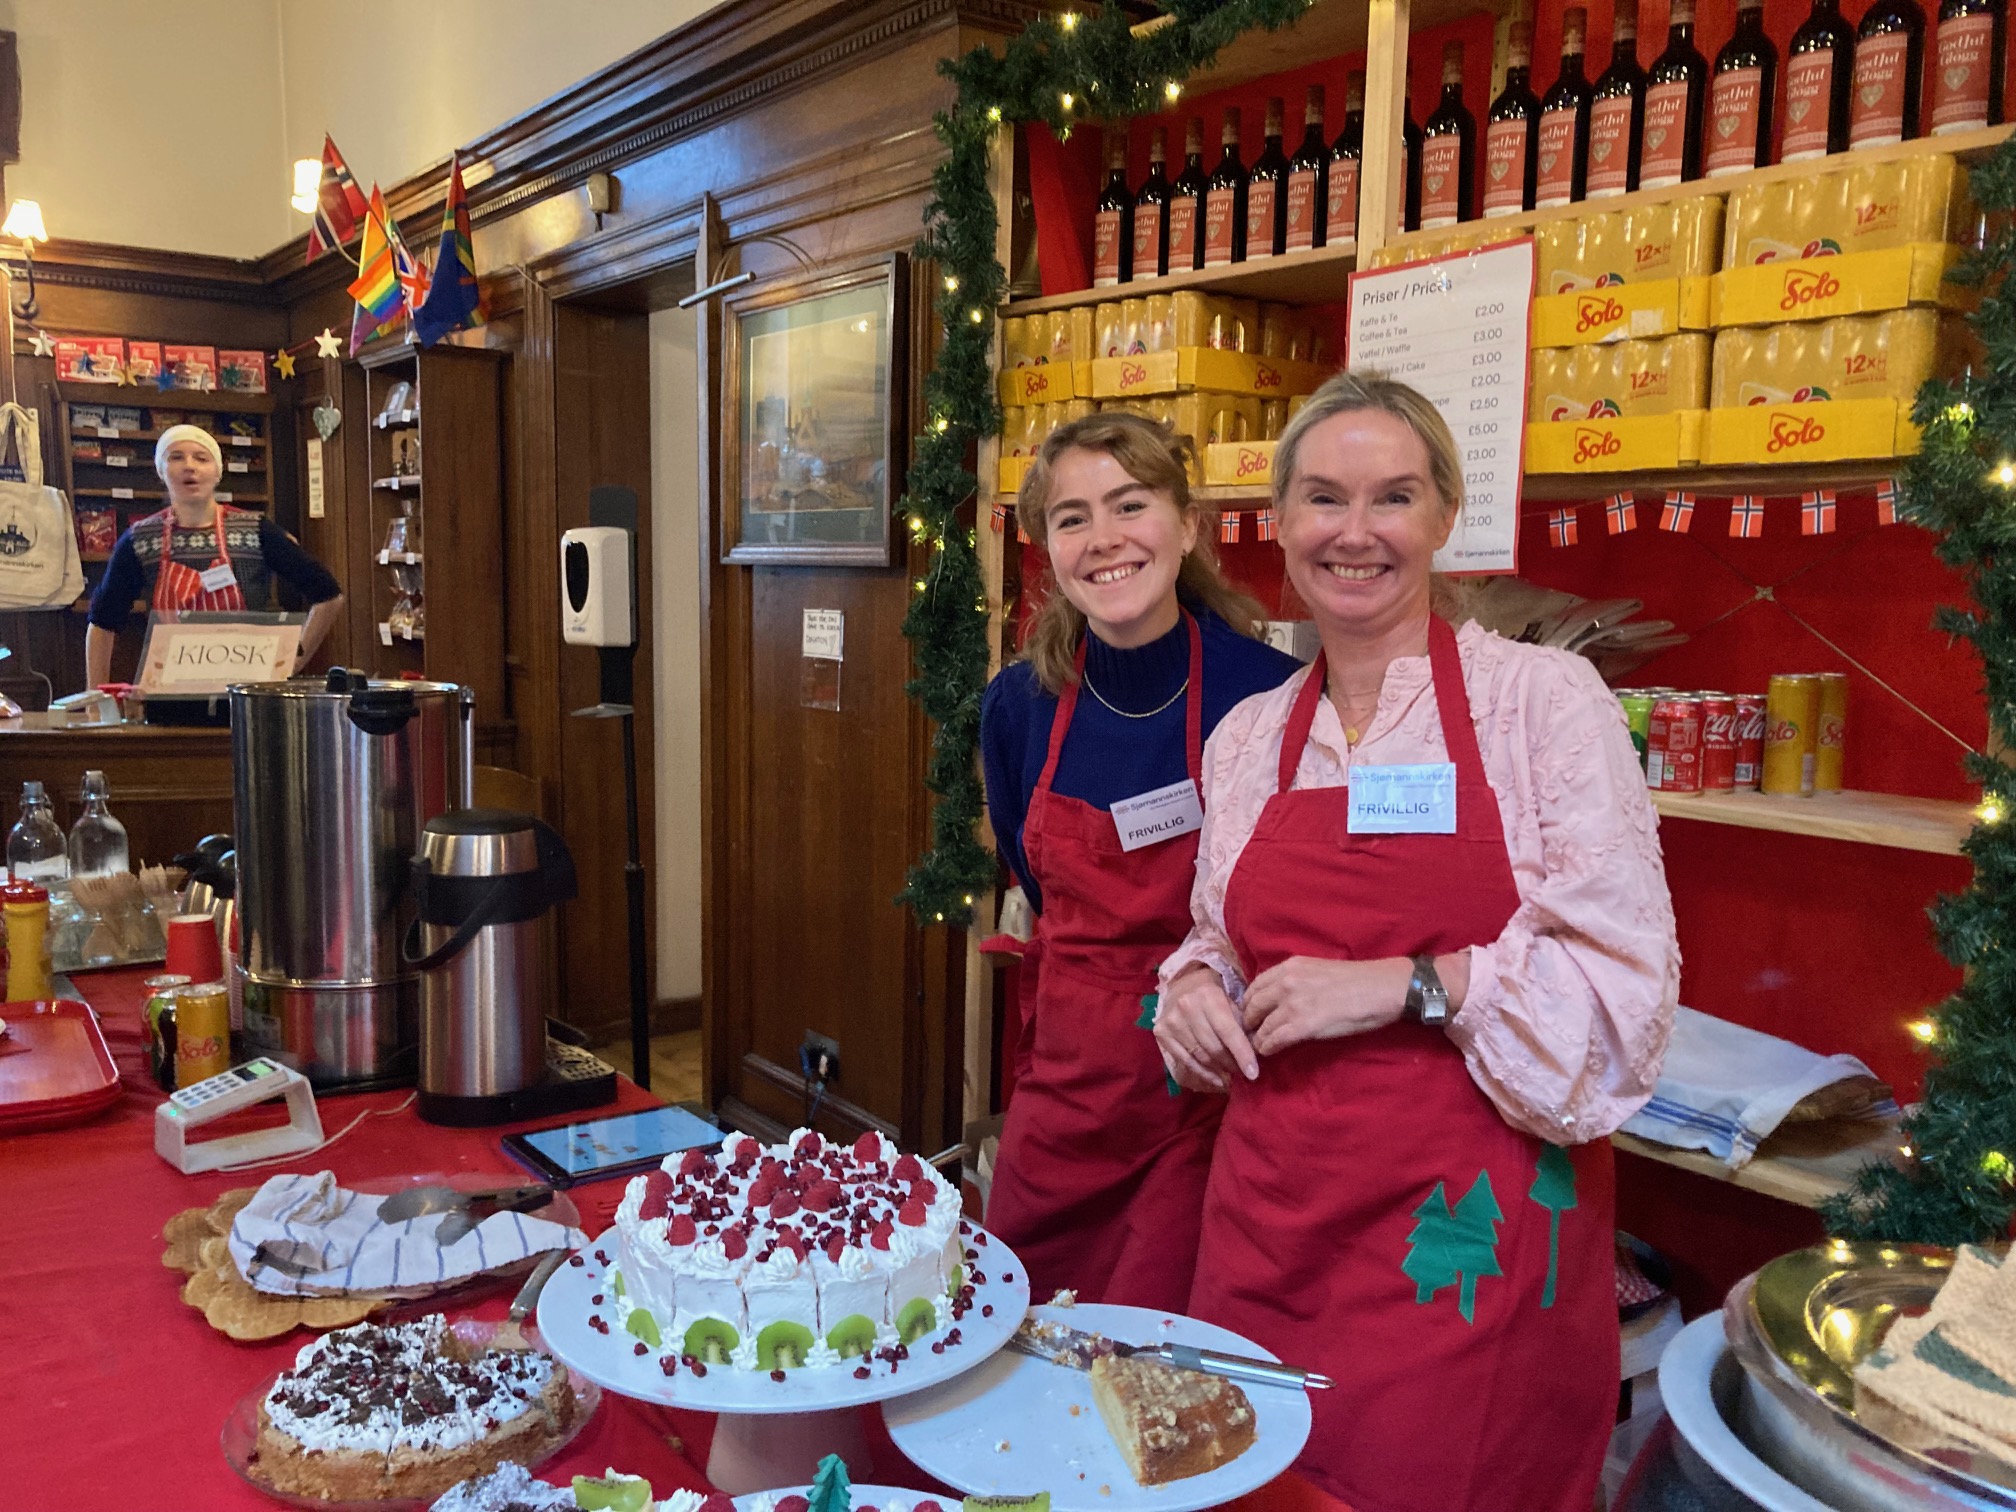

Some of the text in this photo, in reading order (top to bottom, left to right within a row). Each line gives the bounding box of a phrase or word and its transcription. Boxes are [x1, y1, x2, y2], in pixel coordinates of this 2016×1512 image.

[1362, 289, 1399, 306] Priser
[1402, 284, 1409, 300] /
[1780, 271, 1840, 311] Solo
[1475, 303, 1504, 318] £2.00
[1576, 298, 1623, 333] Solo
[1381, 315, 1387, 323] &
[1359, 331, 1384, 343] Coffee
[1386, 328, 1391, 337] &
[1474, 328, 1503, 343] £3.00
[1358, 348, 1379, 361] Vaffel
[1387, 344, 1411, 355] Waffle
[1472, 352, 1502, 366] £3.00
[1407, 361, 1426, 372] Cake
[1025, 373, 1048, 397] Solo
[1120, 364, 1146, 390] Solo
[1254, 368, 1282, 390] Solo
[1471, 373, 1500, 388] £2.00
[1470, 397, 1498, 411] £2.50
[1469, 423, 1498, 436] £5.00
[1767, 417, 1825, 453] Solo
[1467, 448, 1496, 461] £3.00
[1574, 431, 1621, 464] Solo
[1237, 451, 1268, 478] Solo
[1466, 472, 1494, 485] £2.00
[1465, 493, 1493, 506] £3.00
[1464, 515, 1492, 528] £2.00
[178, 644, 266, 665] KIOSK
[1130, 786, 1193, 811] Sjømannskirken
[1357, 802, 1430, 815] FRIVILLIG
[1128, 816, 1184, 840] FRIVILLIG
[180, 1037, 221, 1060] Solo
